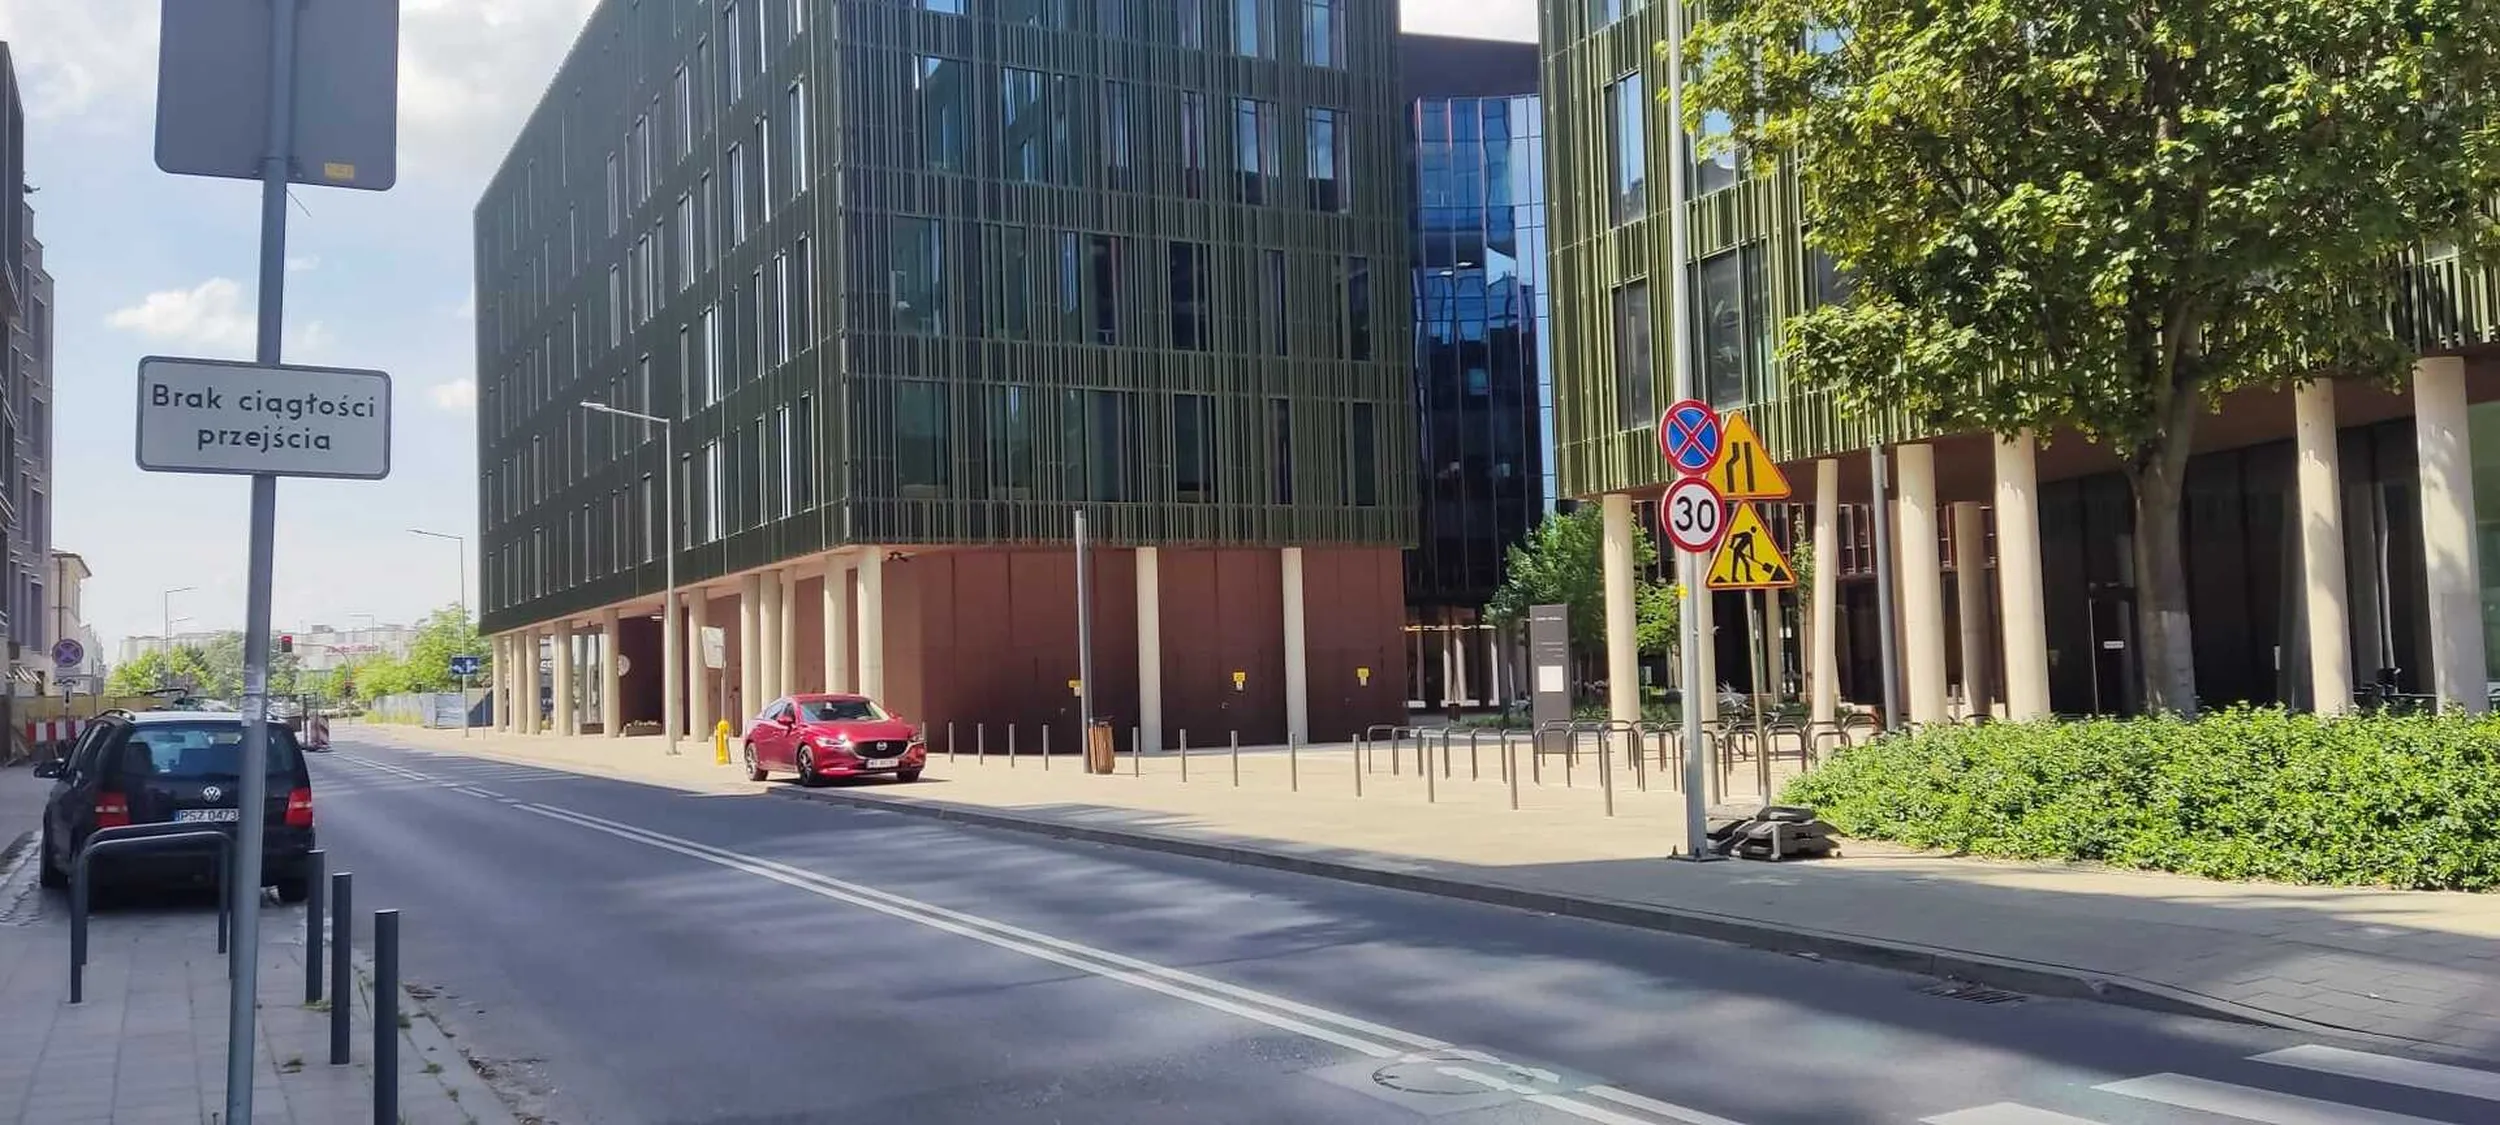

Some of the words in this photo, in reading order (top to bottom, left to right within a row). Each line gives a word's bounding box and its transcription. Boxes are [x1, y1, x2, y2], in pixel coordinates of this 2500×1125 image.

[152, 383, 223, 410] Brak
[239, 389, 375, 421] ciągłości
[197, 425, 331, 453] przejścia
[1675, 496, 1715, 533] 30
[181, 810, 205, 821] PSZ
[208, 809, 240, 821] 0473
